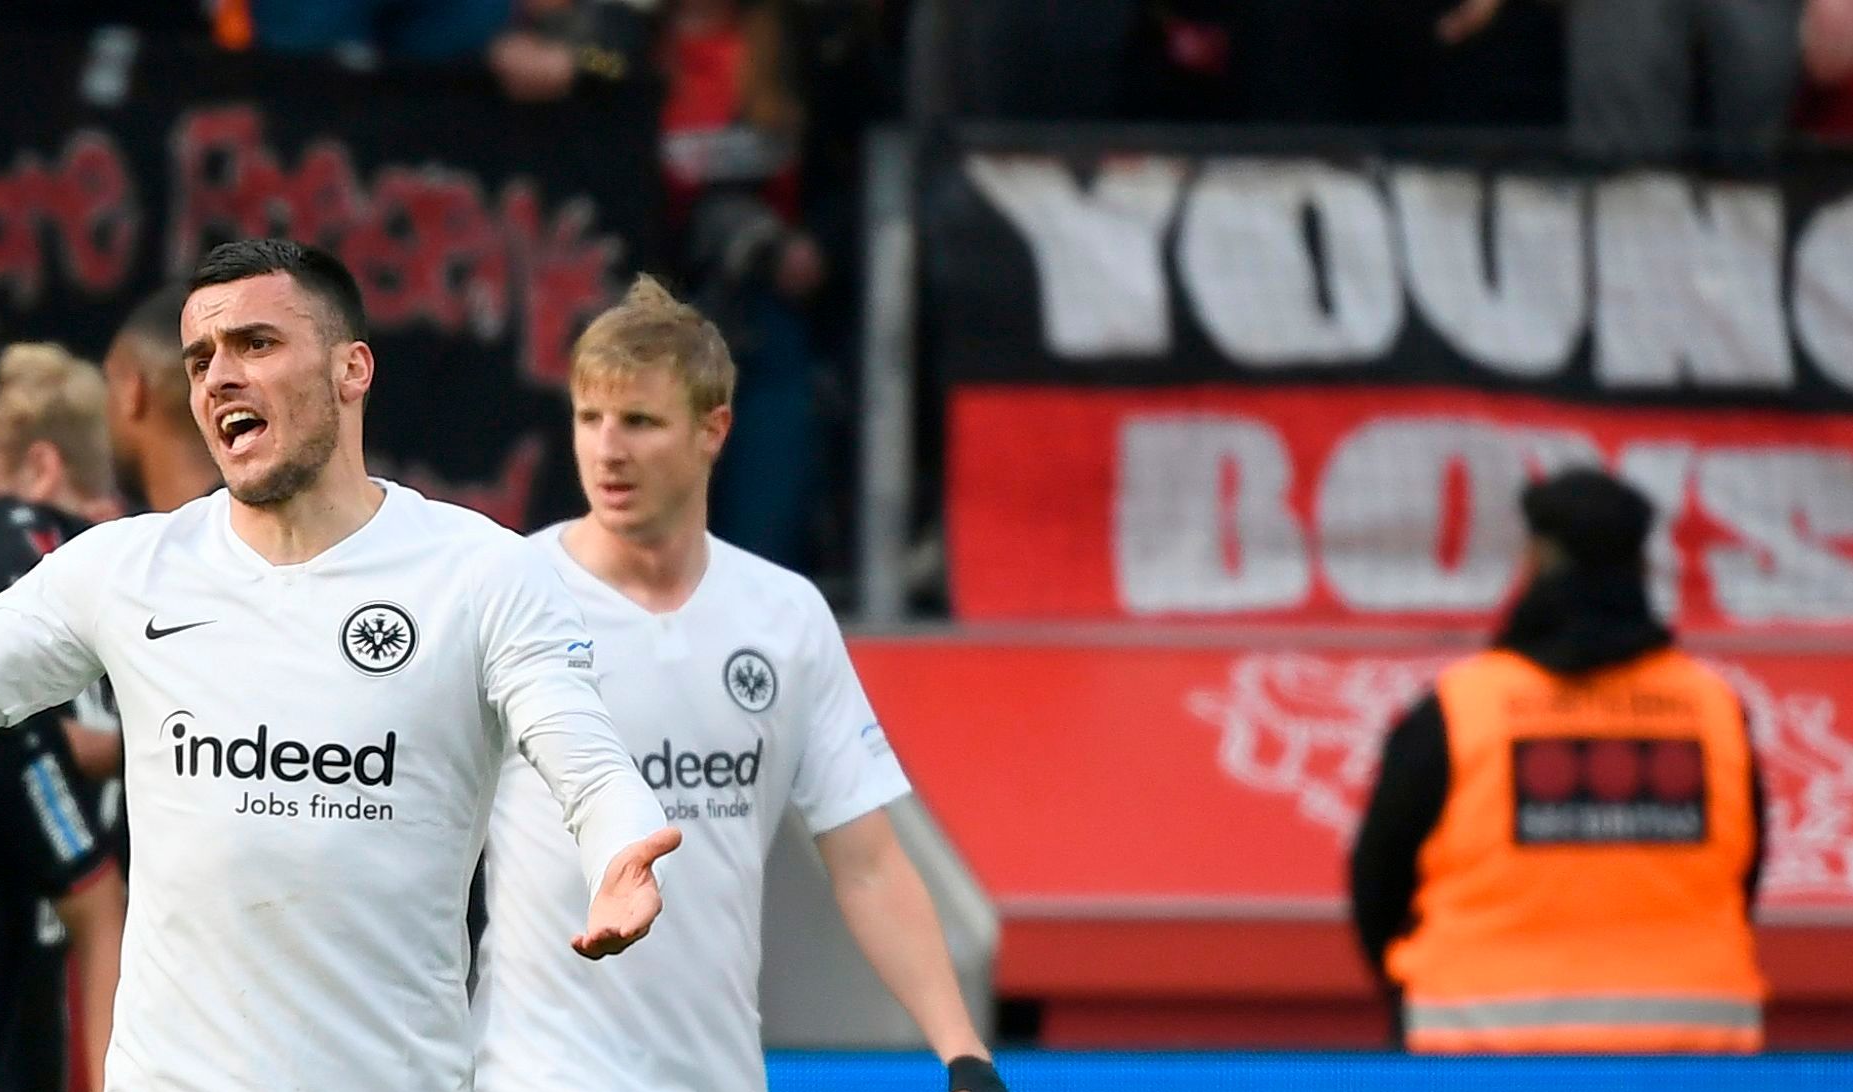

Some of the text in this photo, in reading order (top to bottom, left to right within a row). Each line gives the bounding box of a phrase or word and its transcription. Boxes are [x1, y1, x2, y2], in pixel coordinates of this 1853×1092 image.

[159, 710, 397, 787] indeed
[630, 737, 764, 791] deed
[235, 791, 394, 821] Jobs finden
[661, 798, 700, 821] obs
